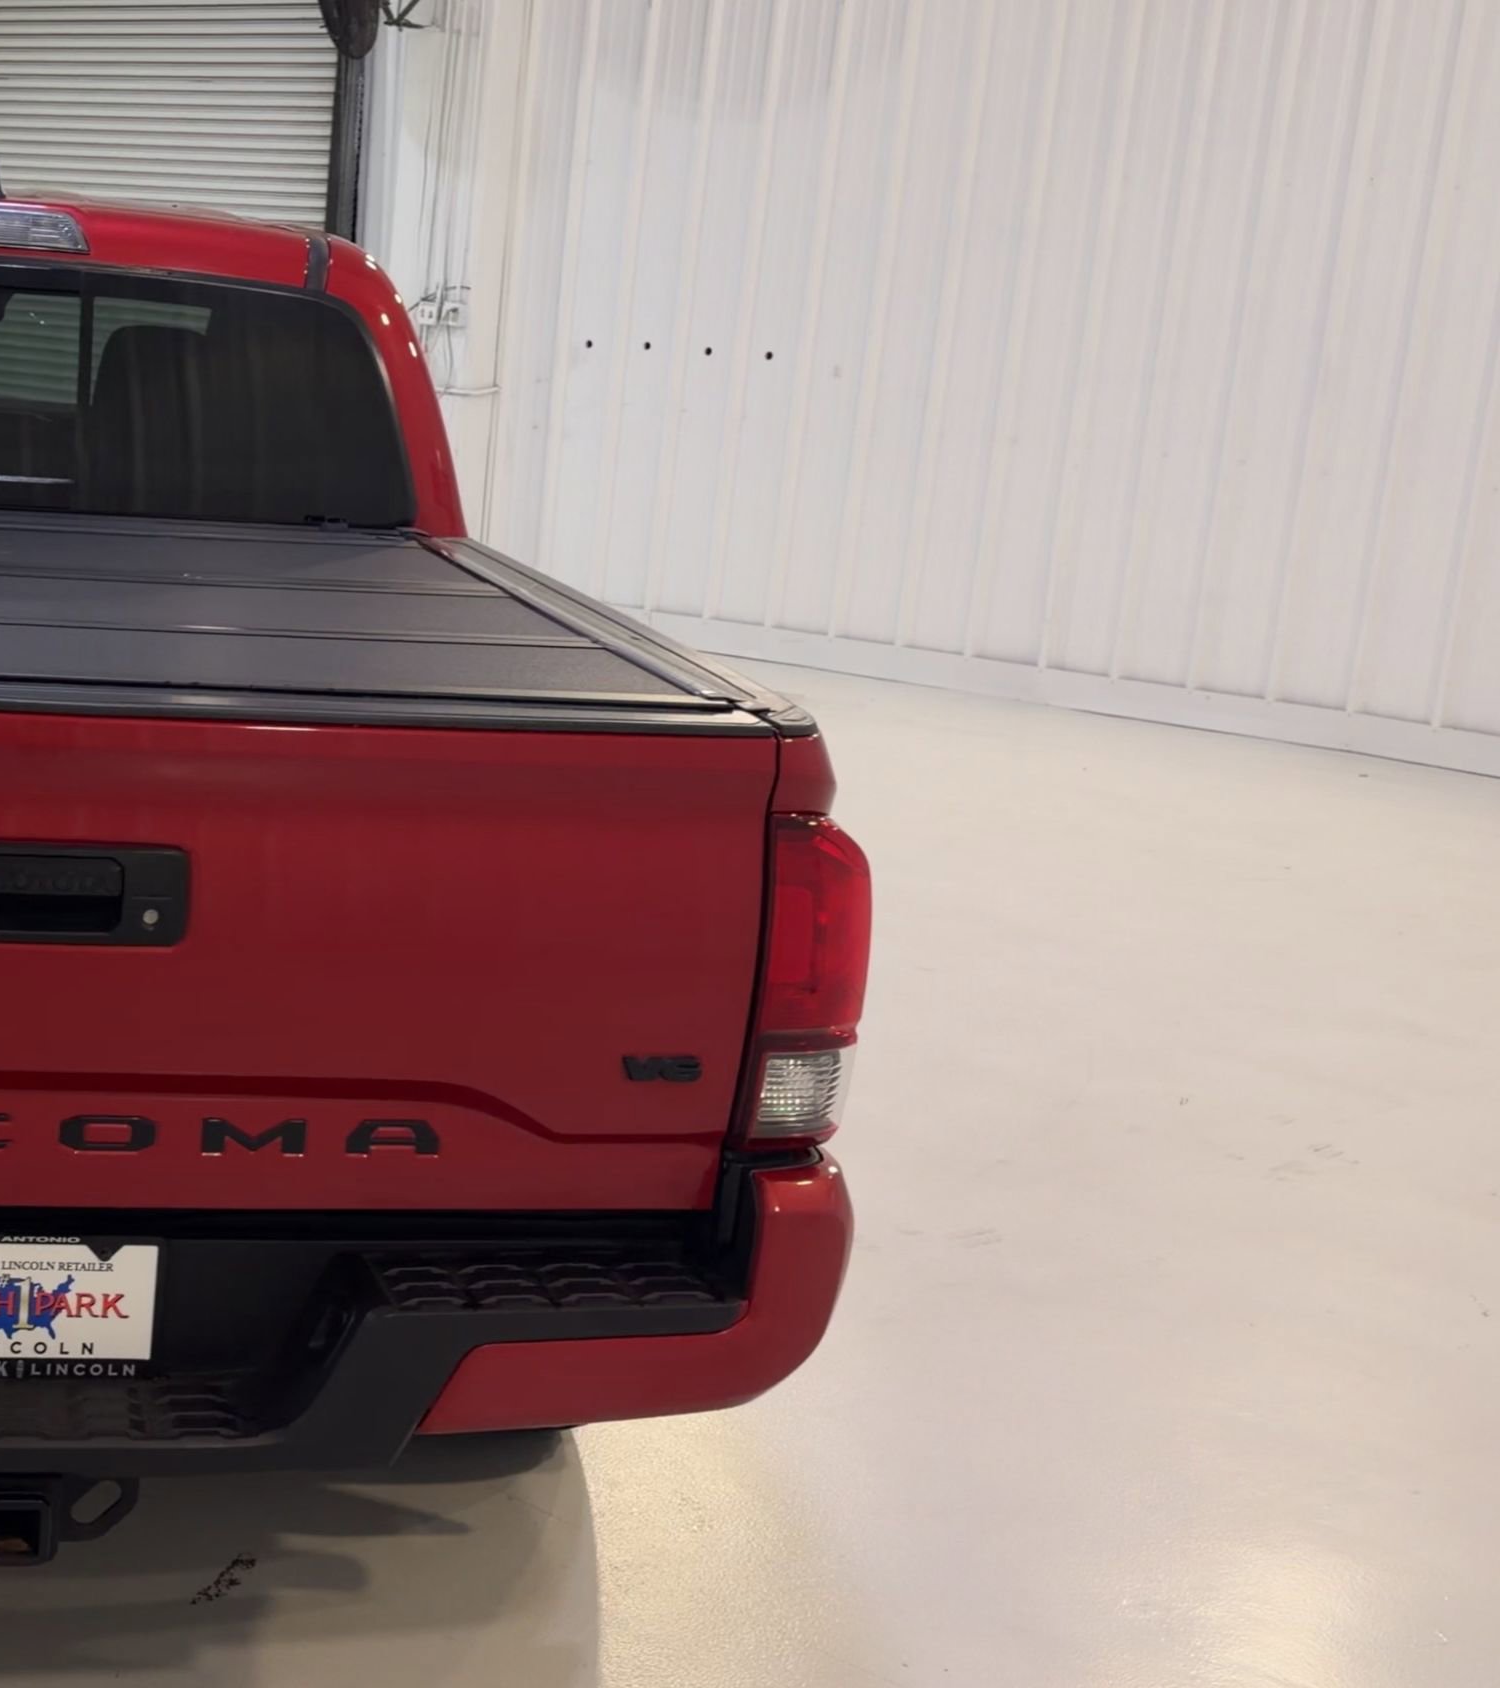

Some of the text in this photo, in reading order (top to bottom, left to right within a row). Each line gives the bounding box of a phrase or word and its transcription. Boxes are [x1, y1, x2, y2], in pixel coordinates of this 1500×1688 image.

[621, 1055, 703, 1081] V6
[0, 1235, 81, 1244] ANTONIO
[1, 1261, 56, 1271] LINCOLN
[58, 1262, 114, 1272] RETAILER
[35, 1292, 130, 1318] PARK
[31, 1363, 136, 1376] LINCOLN
